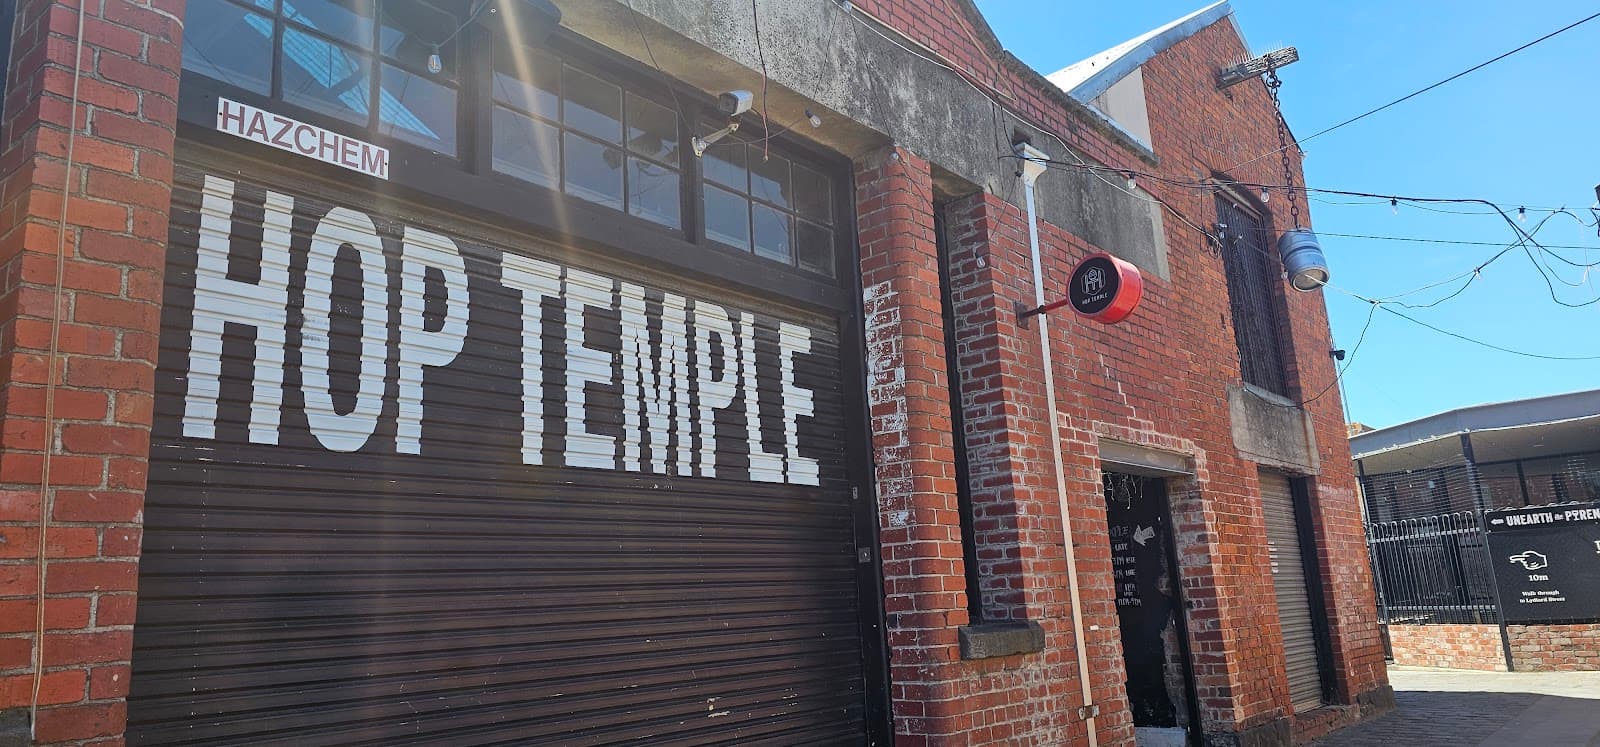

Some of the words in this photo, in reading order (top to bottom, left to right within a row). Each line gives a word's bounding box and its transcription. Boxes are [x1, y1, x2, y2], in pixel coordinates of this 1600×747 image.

[221, 101, 386, 177] HAZCHEM
[1091, 293, 1108, 302] TEMPLE
[182, 174, 470, 455] HOP
[500, 252, 820, 487] TEMPLE
[1506, 512, 1553, 526] UNEARTH
